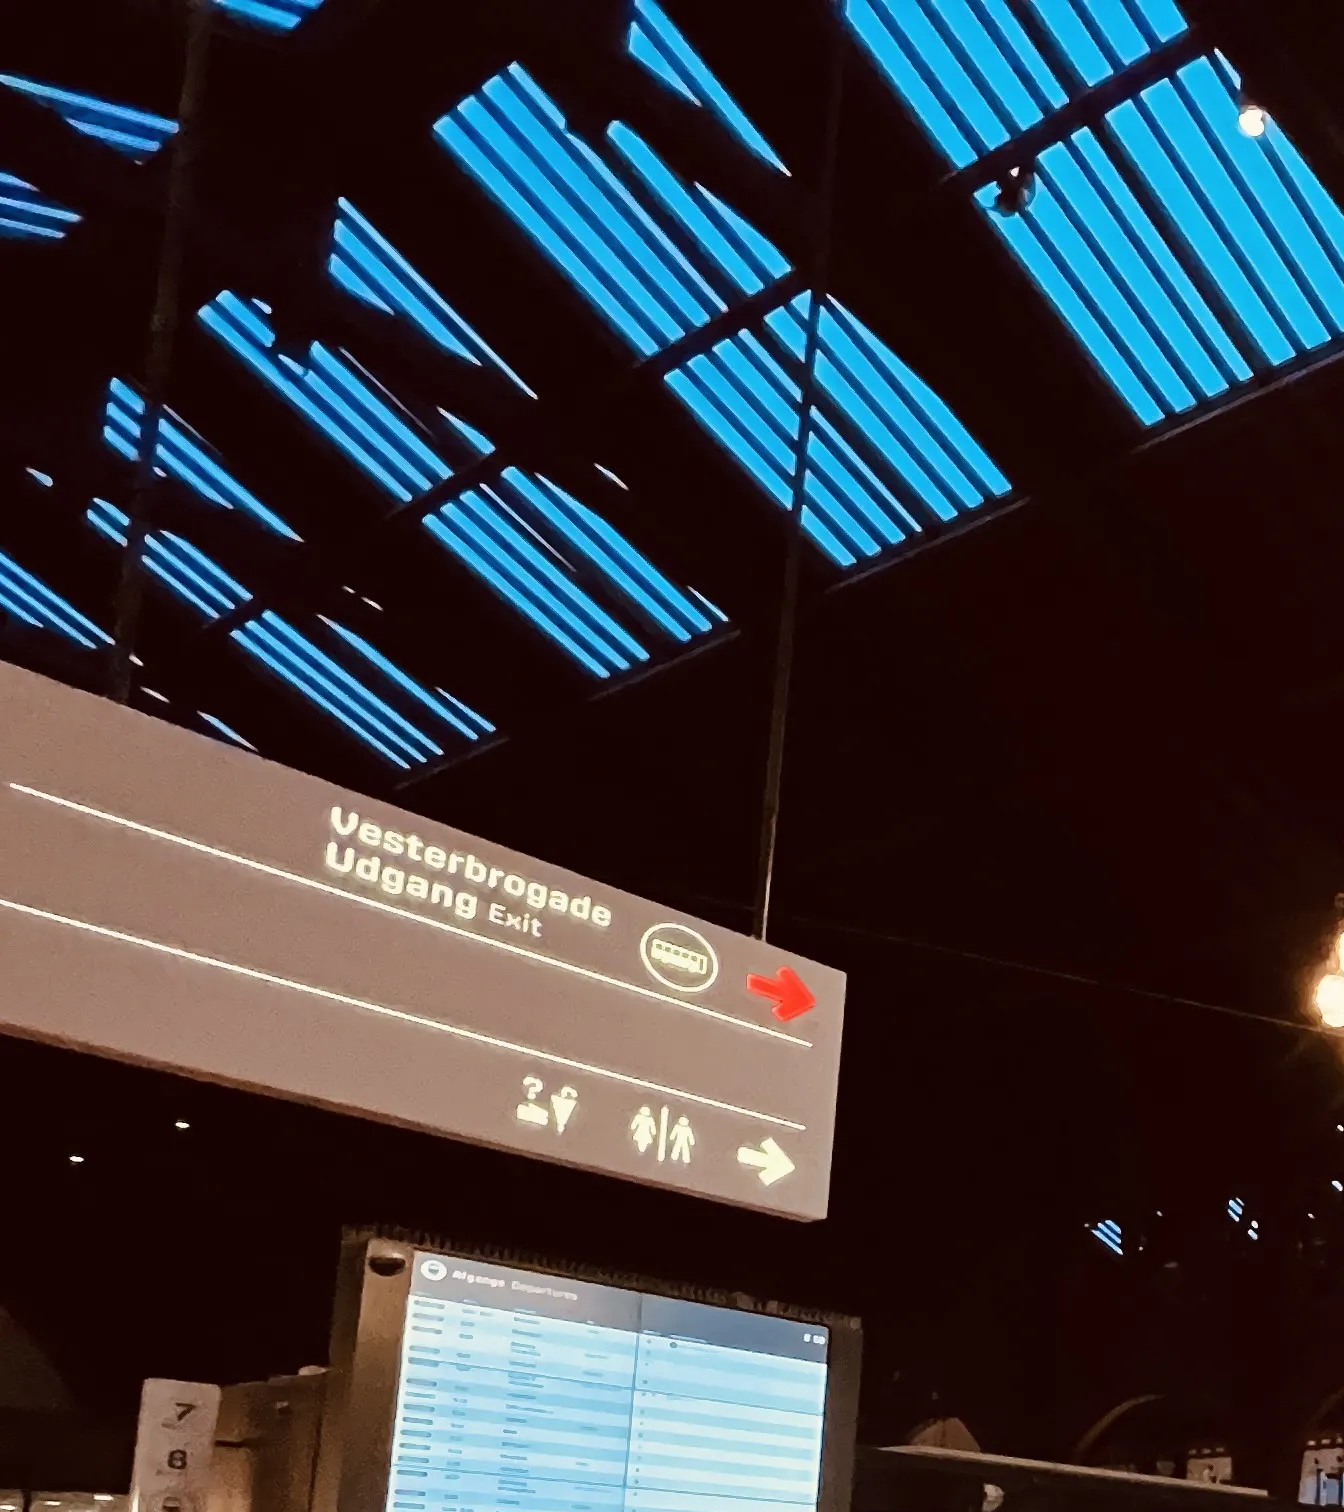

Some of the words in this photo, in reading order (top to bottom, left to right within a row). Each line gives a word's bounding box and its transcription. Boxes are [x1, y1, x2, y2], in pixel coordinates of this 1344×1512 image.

[326, 843, 478, 918] Udgang
[488, 903, 543, 938] Exit
[330, 806, 612, 927] Vesterbrogade
[175, 1402, 197, 1422] 7
[167, 1449, 188, 1470] 8
